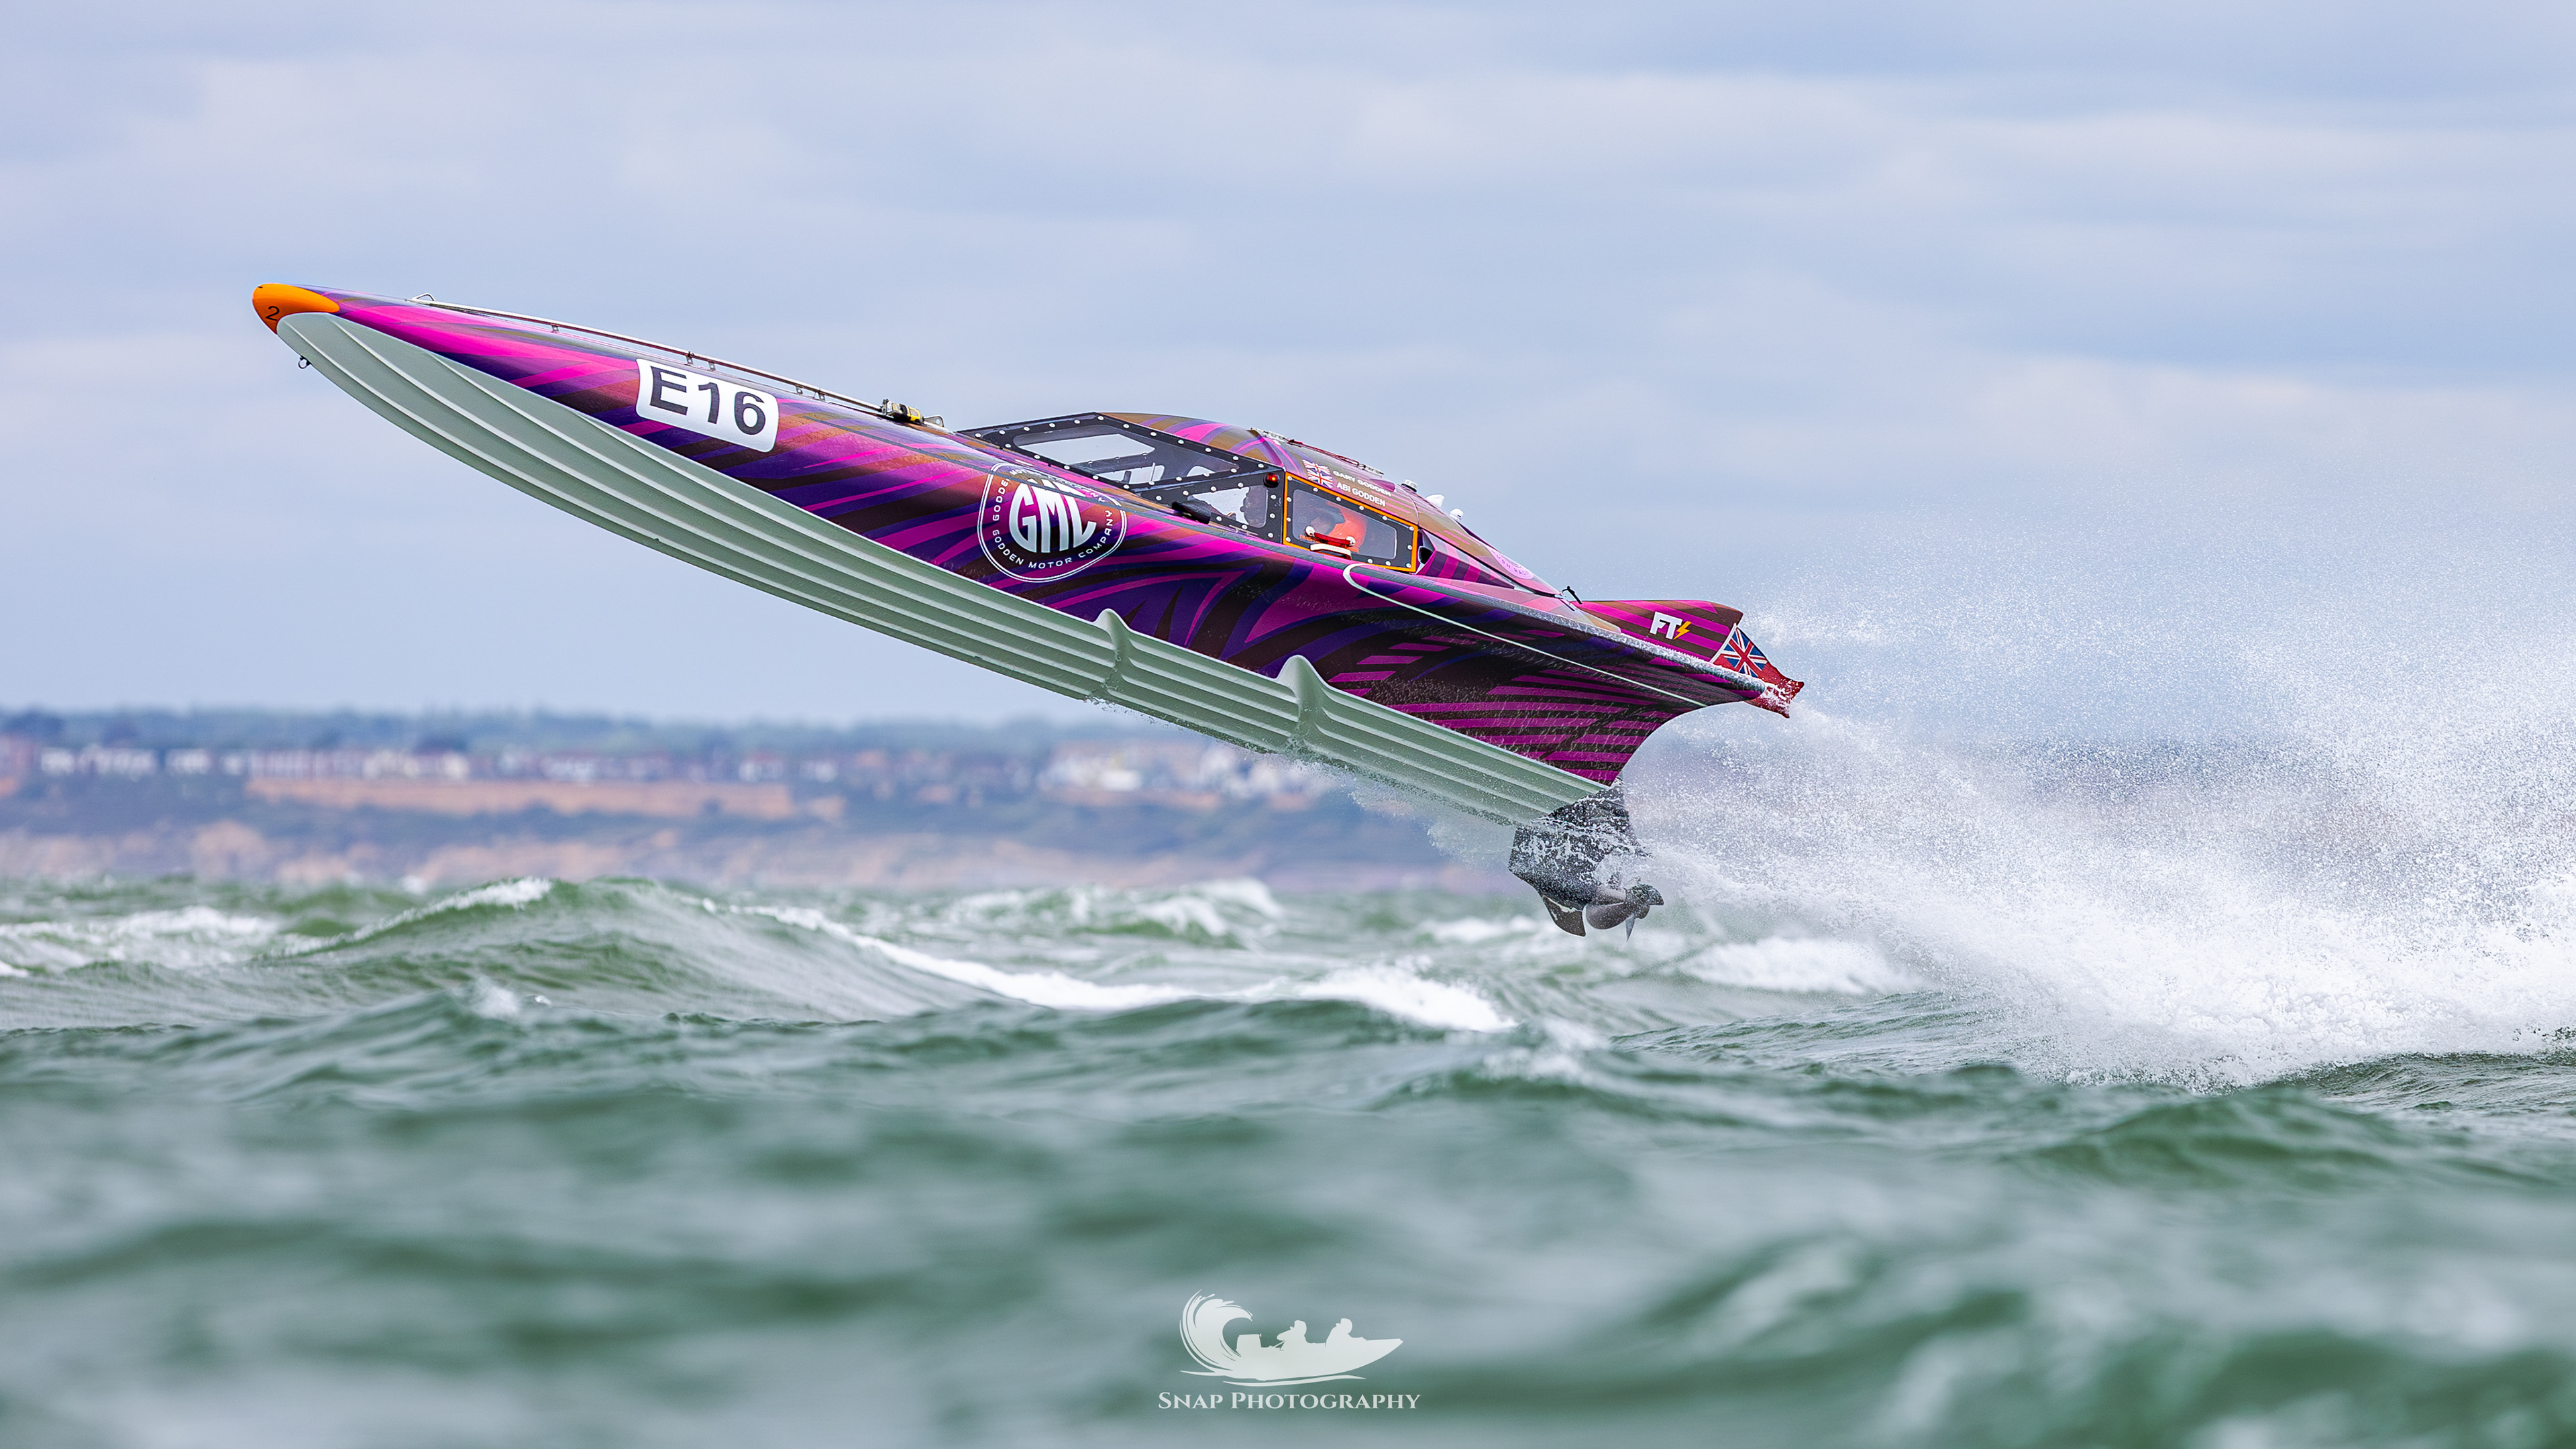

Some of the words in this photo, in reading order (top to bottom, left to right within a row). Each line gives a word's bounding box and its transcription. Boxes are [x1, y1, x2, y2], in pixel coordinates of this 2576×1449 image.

[265, 305, 280, 321] 2
[649, 366, 766, 435] E16
[993, 478, 1010, 521] GODDE
[1332, 470, 1356, 482] GARY
[1357, 479, 1392, 497] GODDEN
[1336, 482, 1351, 493] ABI
[1352, 488, 1386, 507] GODDEN
[1009, 478, 1097, 553] GML
[992, 529, 1024, 565] GODDEN
[1028, 557, 1073, 569] MOTOR
[1078, 511, 1114, 558] COMPANY
[1650, 611, 1683, 639] FT
